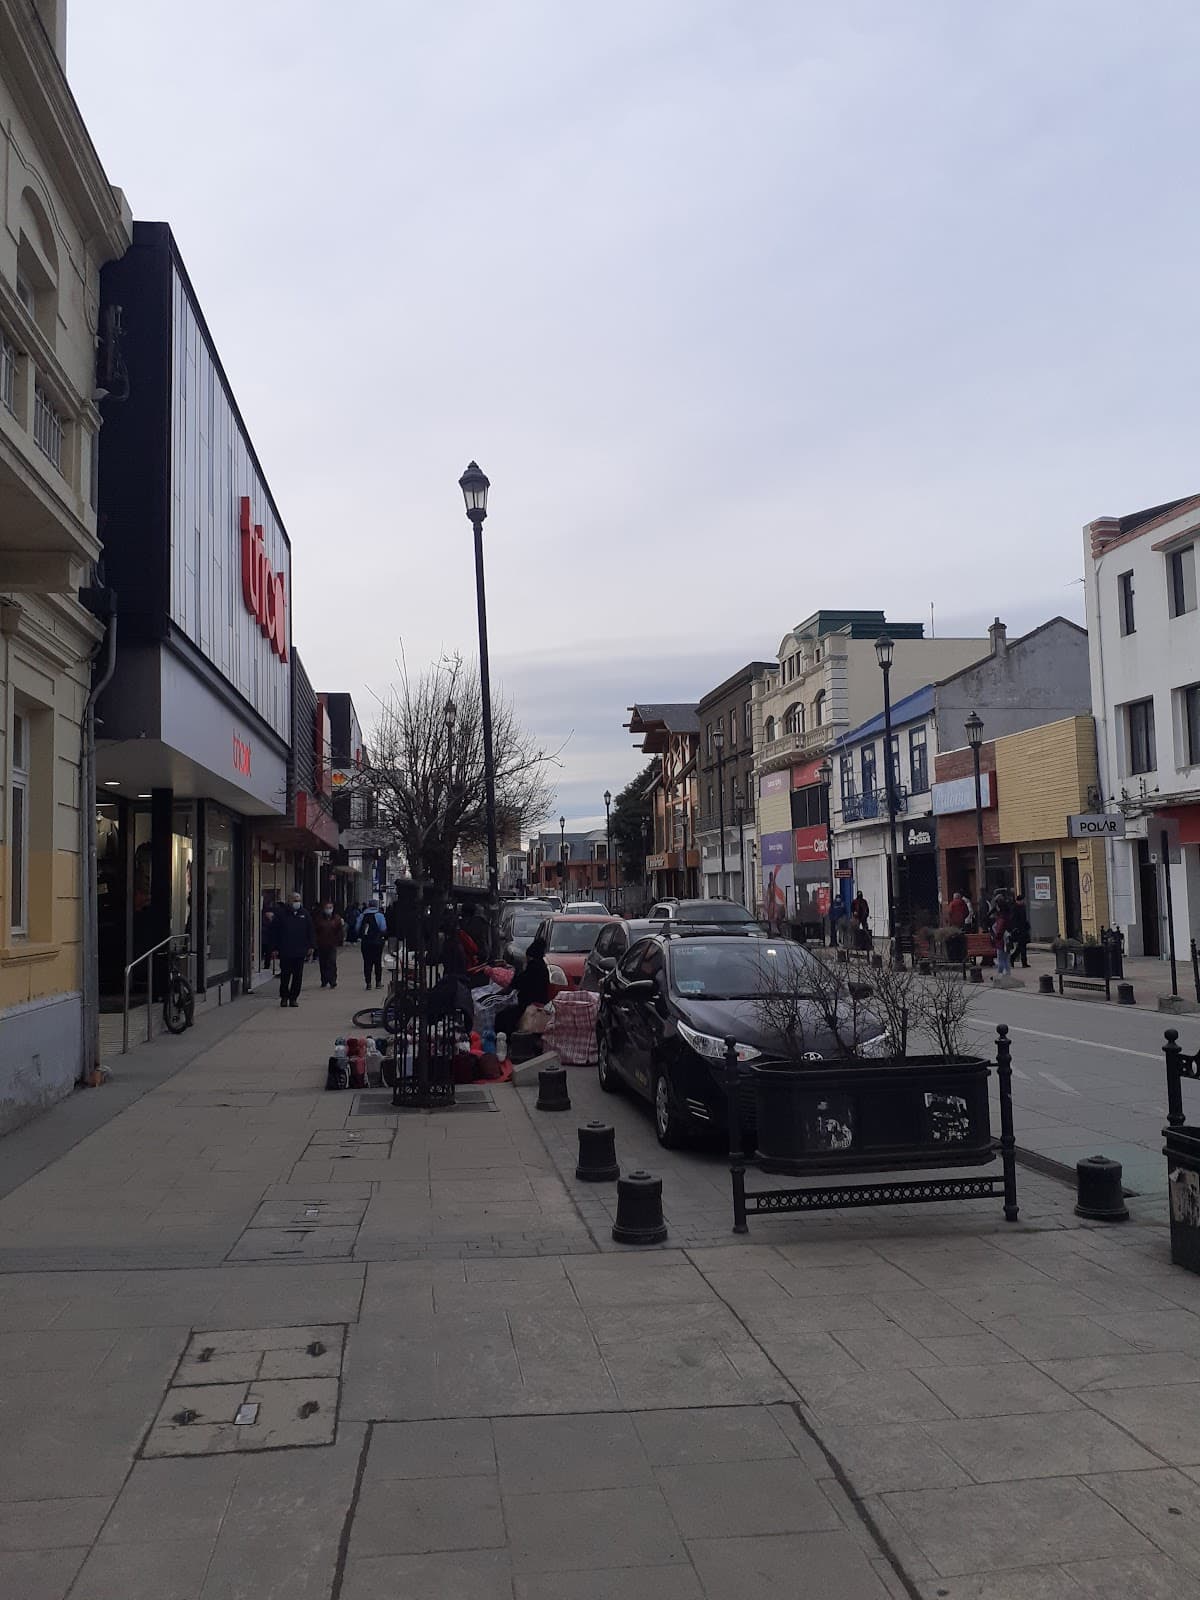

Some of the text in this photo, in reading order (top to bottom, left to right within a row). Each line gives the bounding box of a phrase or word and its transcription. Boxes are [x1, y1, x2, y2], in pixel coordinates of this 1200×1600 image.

[240, 496, 288, 664] tricot
[232, 729, 251, 777] tricot
[1080, 820, 1117, 833] POLAR
